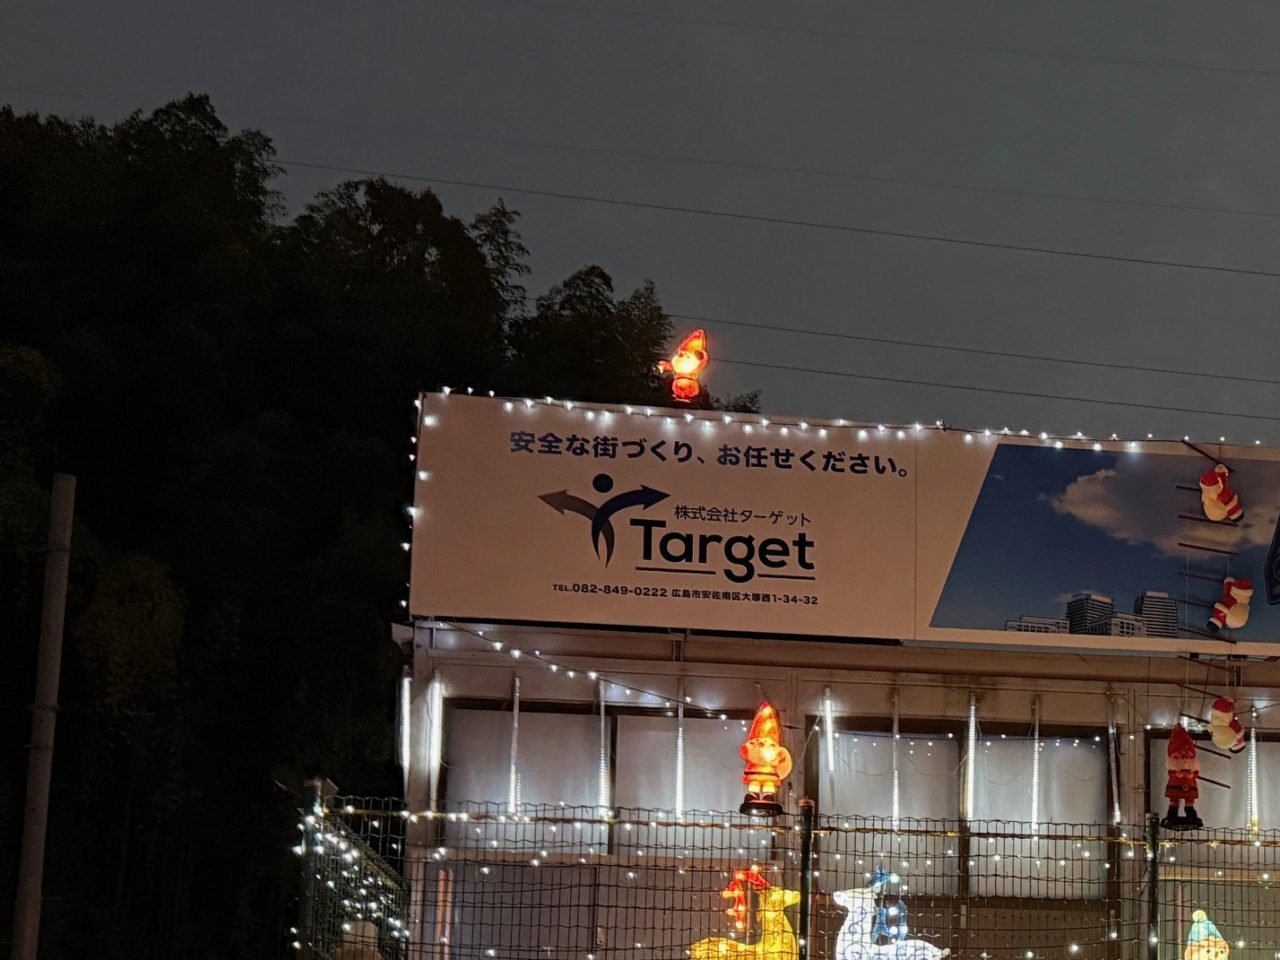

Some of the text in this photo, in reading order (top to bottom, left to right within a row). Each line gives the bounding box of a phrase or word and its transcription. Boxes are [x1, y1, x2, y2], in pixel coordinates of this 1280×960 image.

[510, 431, 908, 478] 安全な街づくり、お任せください。
[674, 504, 811, 526] 株式会社ターゲット
[630, 518, 816, 583] Target
[552, 583, 668, 598] TEL.082-849-0222
